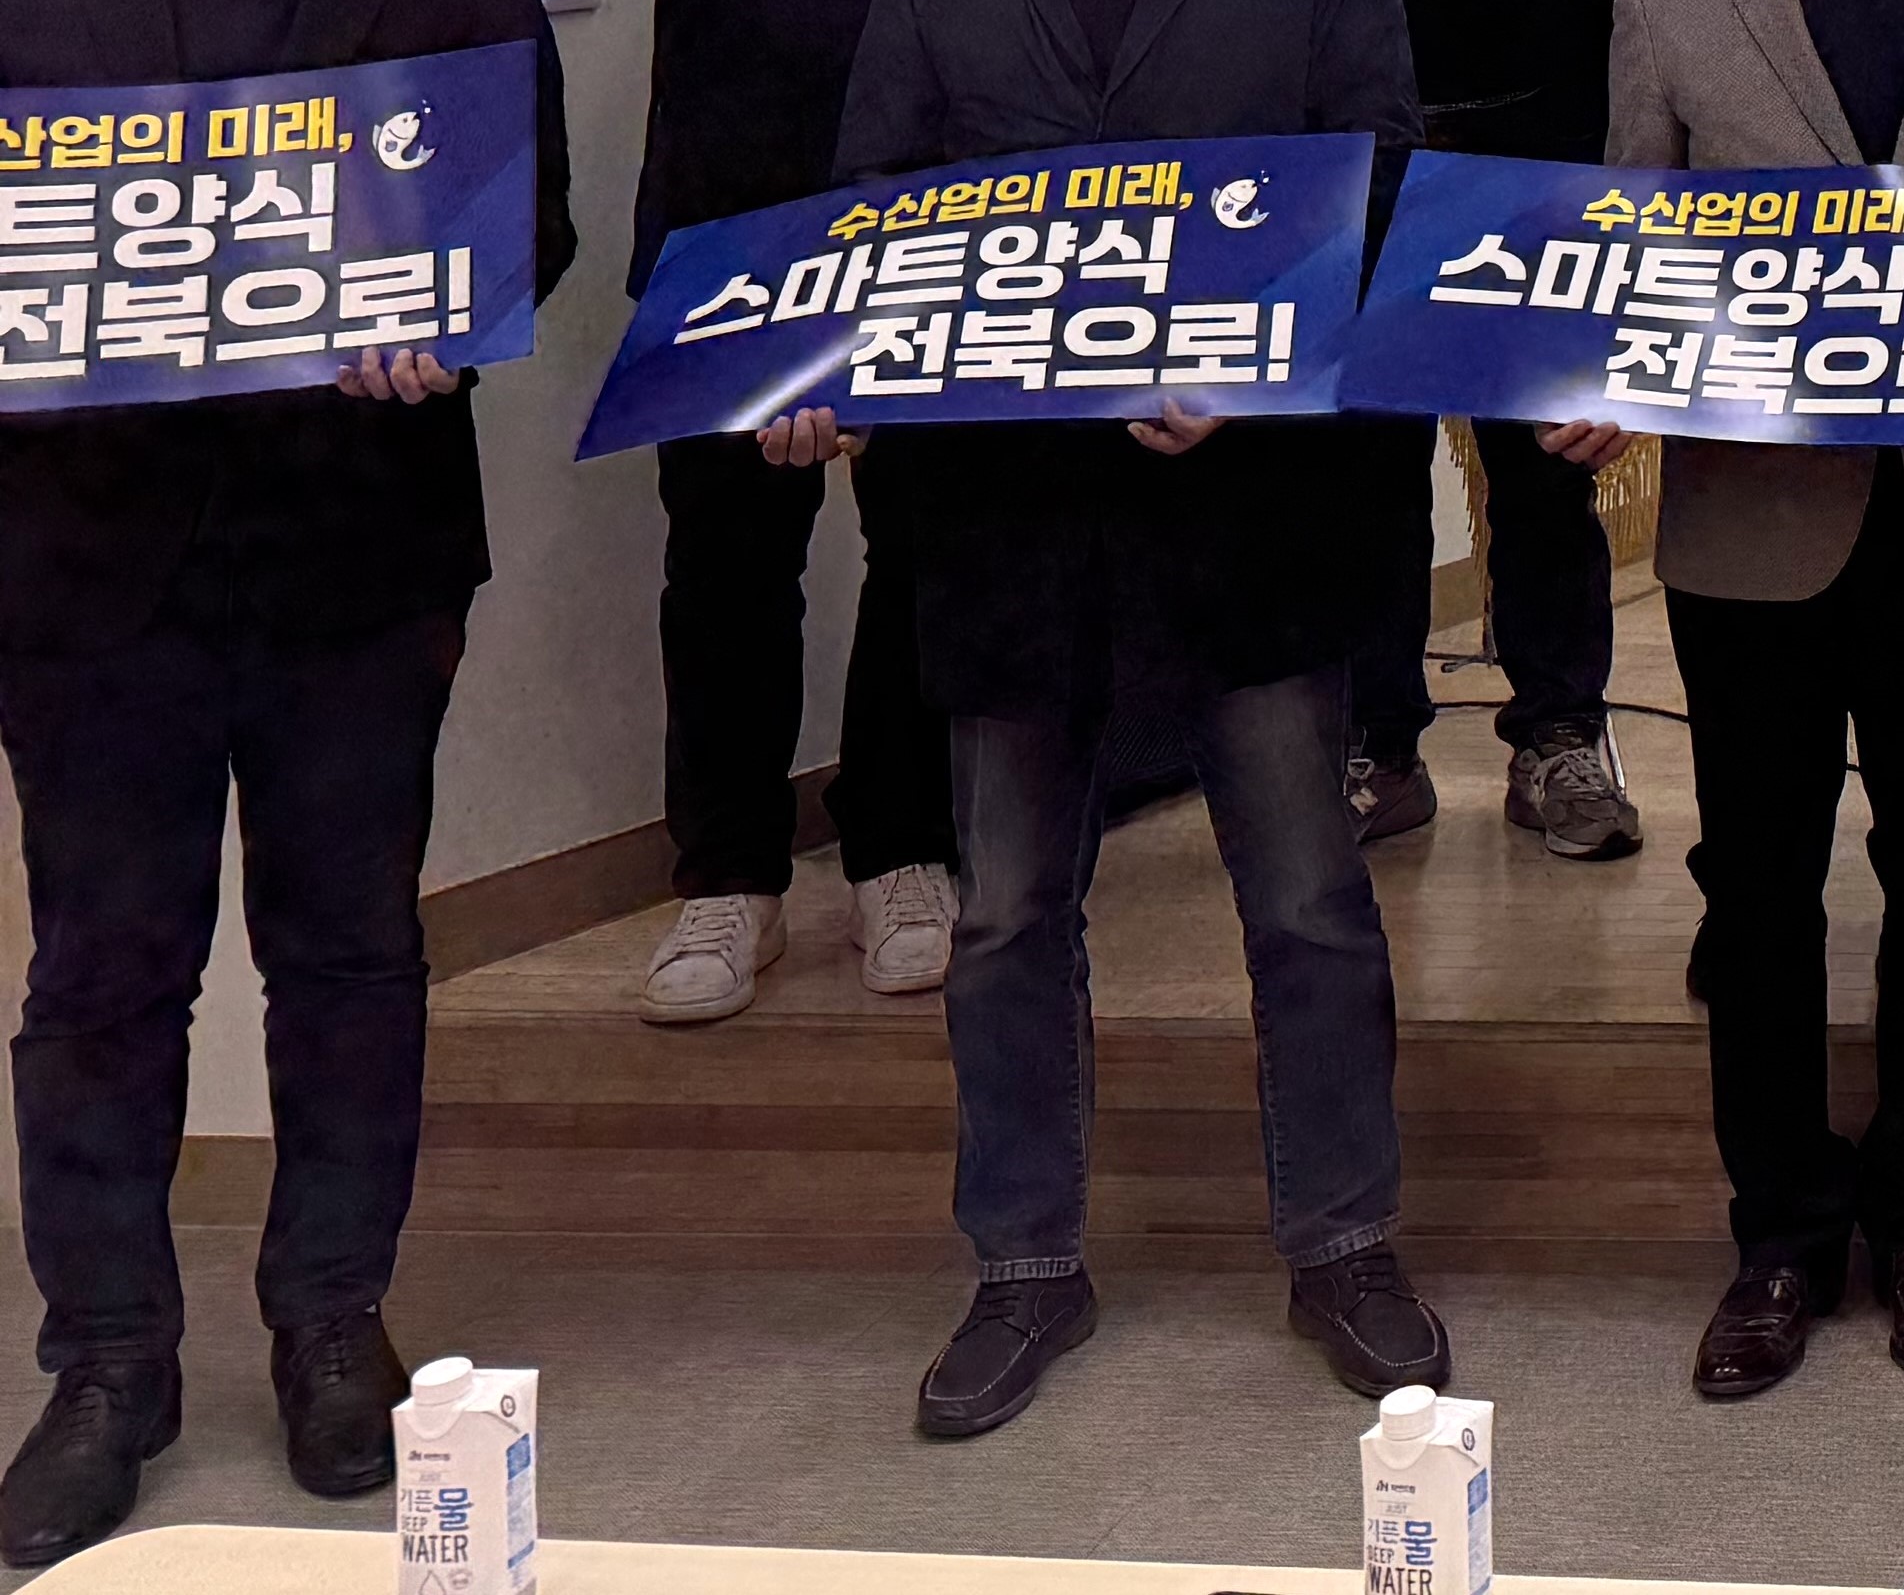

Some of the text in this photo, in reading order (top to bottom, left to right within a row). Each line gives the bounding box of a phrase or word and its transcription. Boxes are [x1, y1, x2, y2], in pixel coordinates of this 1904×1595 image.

[207, 96, 354, 158] 미래,
[0, 162, 336, 274] 트양식
[827, 161, 1194, 241] 수산업의 미래,
[1582, 188, 1799, 237] 수산업의
[673, 215, 1174, 345] 스마트양식
[0, 247, 471, 381] 전북으로!
[850, 302, 1295, 396] 전북으로!
[433, 1488, 474, 1532] 물
[402, 1535, 468, 1562] WATER
[1400, 1521, 1437, 1565] 물
[1367, 1566, 1432, 1595] WATER
